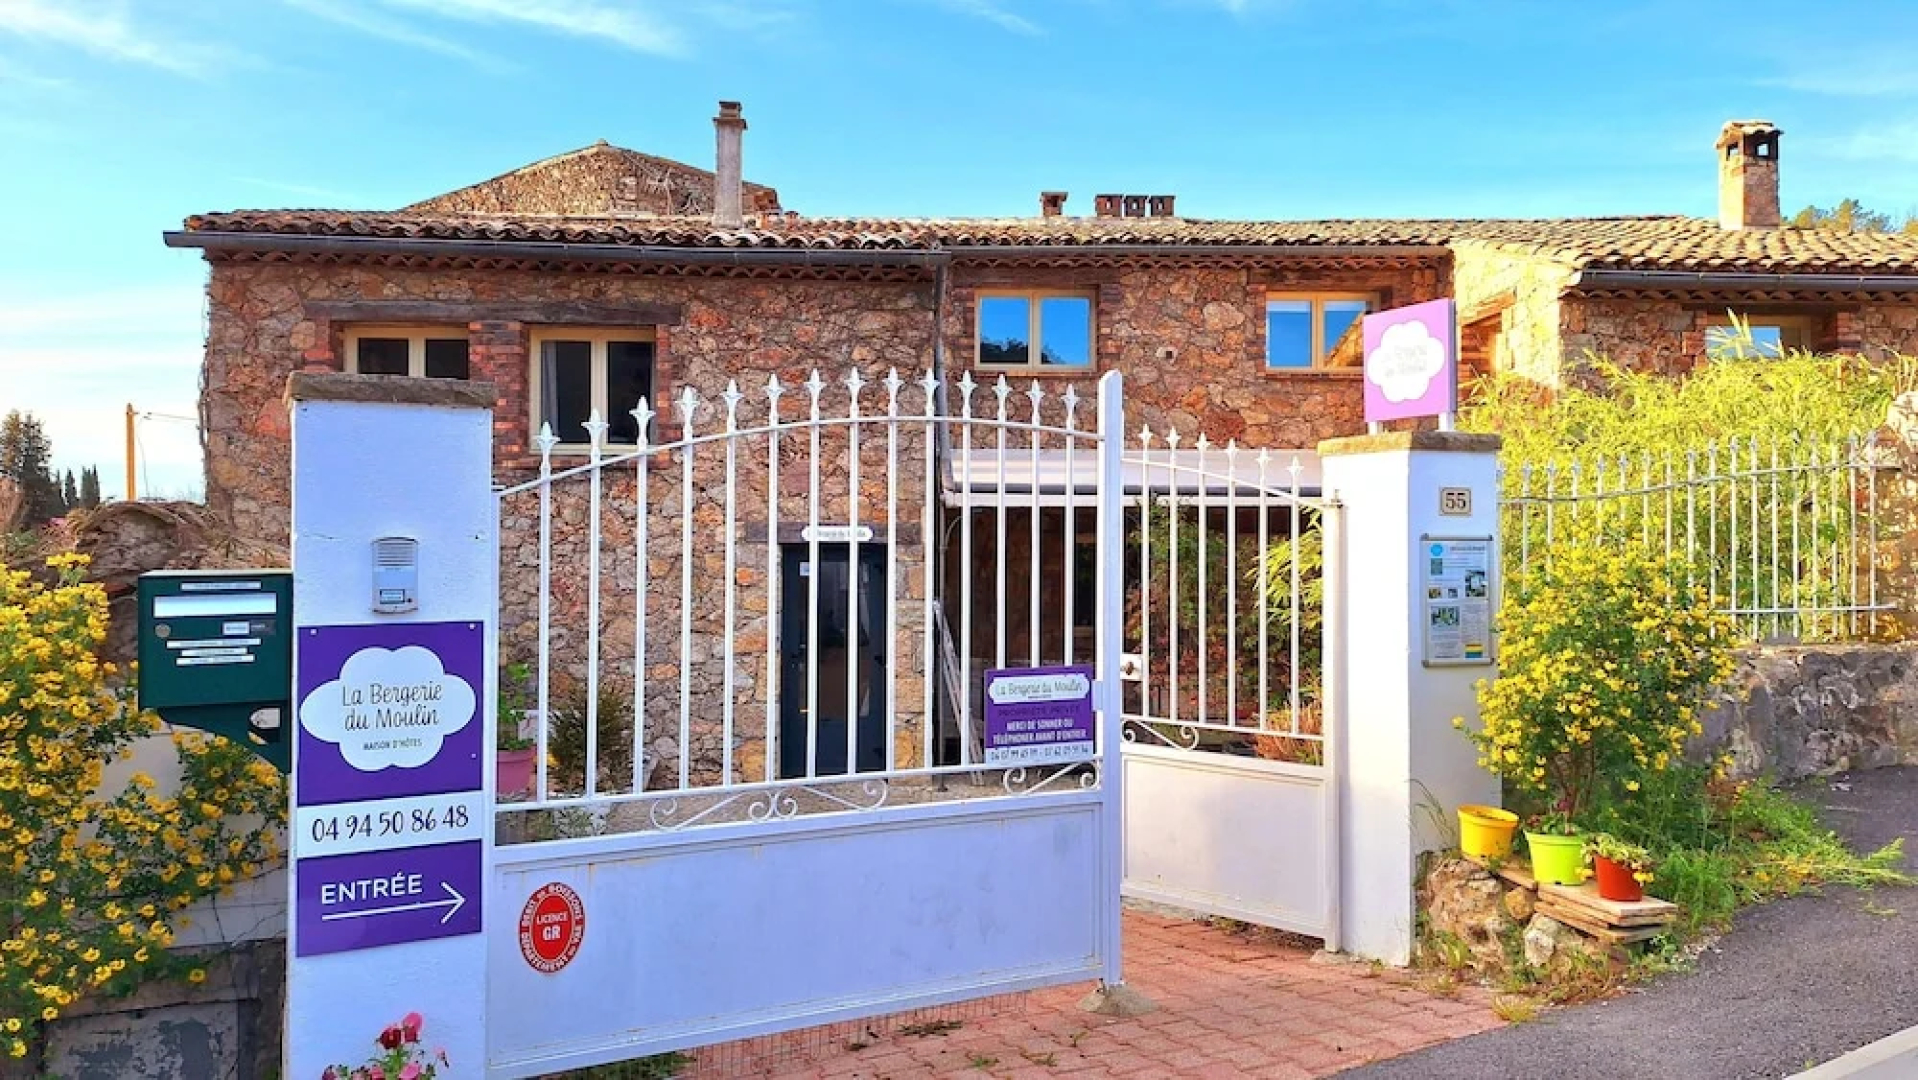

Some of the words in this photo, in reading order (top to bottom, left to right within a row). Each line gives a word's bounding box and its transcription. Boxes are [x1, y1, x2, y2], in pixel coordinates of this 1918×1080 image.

[1446, 492, 1466, 509] 55
[341, 685, 364, 707] La
[369, 681, 443, 707] Bergerie
[1008, 682, 1040, 697] Bergerie
[1054, 679, 1082, 692] Moulin
[344, 708, 370, 731] du
[375, 704, 439, 729] Moulin
[1006, 720, 1027, 731] MERCI
[1028, 720, 1036, 730] DE
[1037, 718, 1062, 729] SONNER
[1035, 730, 1056, 742] AVANT
[363, 740, 390, 751] MAISON
[312, 817, 339, 842] 04
[346, 814, 373, 839] 94
[379, 811, 404, 837] 50
[411, 807, 437, 833] 86
[442, 804, 469, 828] 48
[320, 870, 423, 905] ENTRÉE
[536, 911, 568, 925] LICENCE
[542, 924, 561, 941] GR
